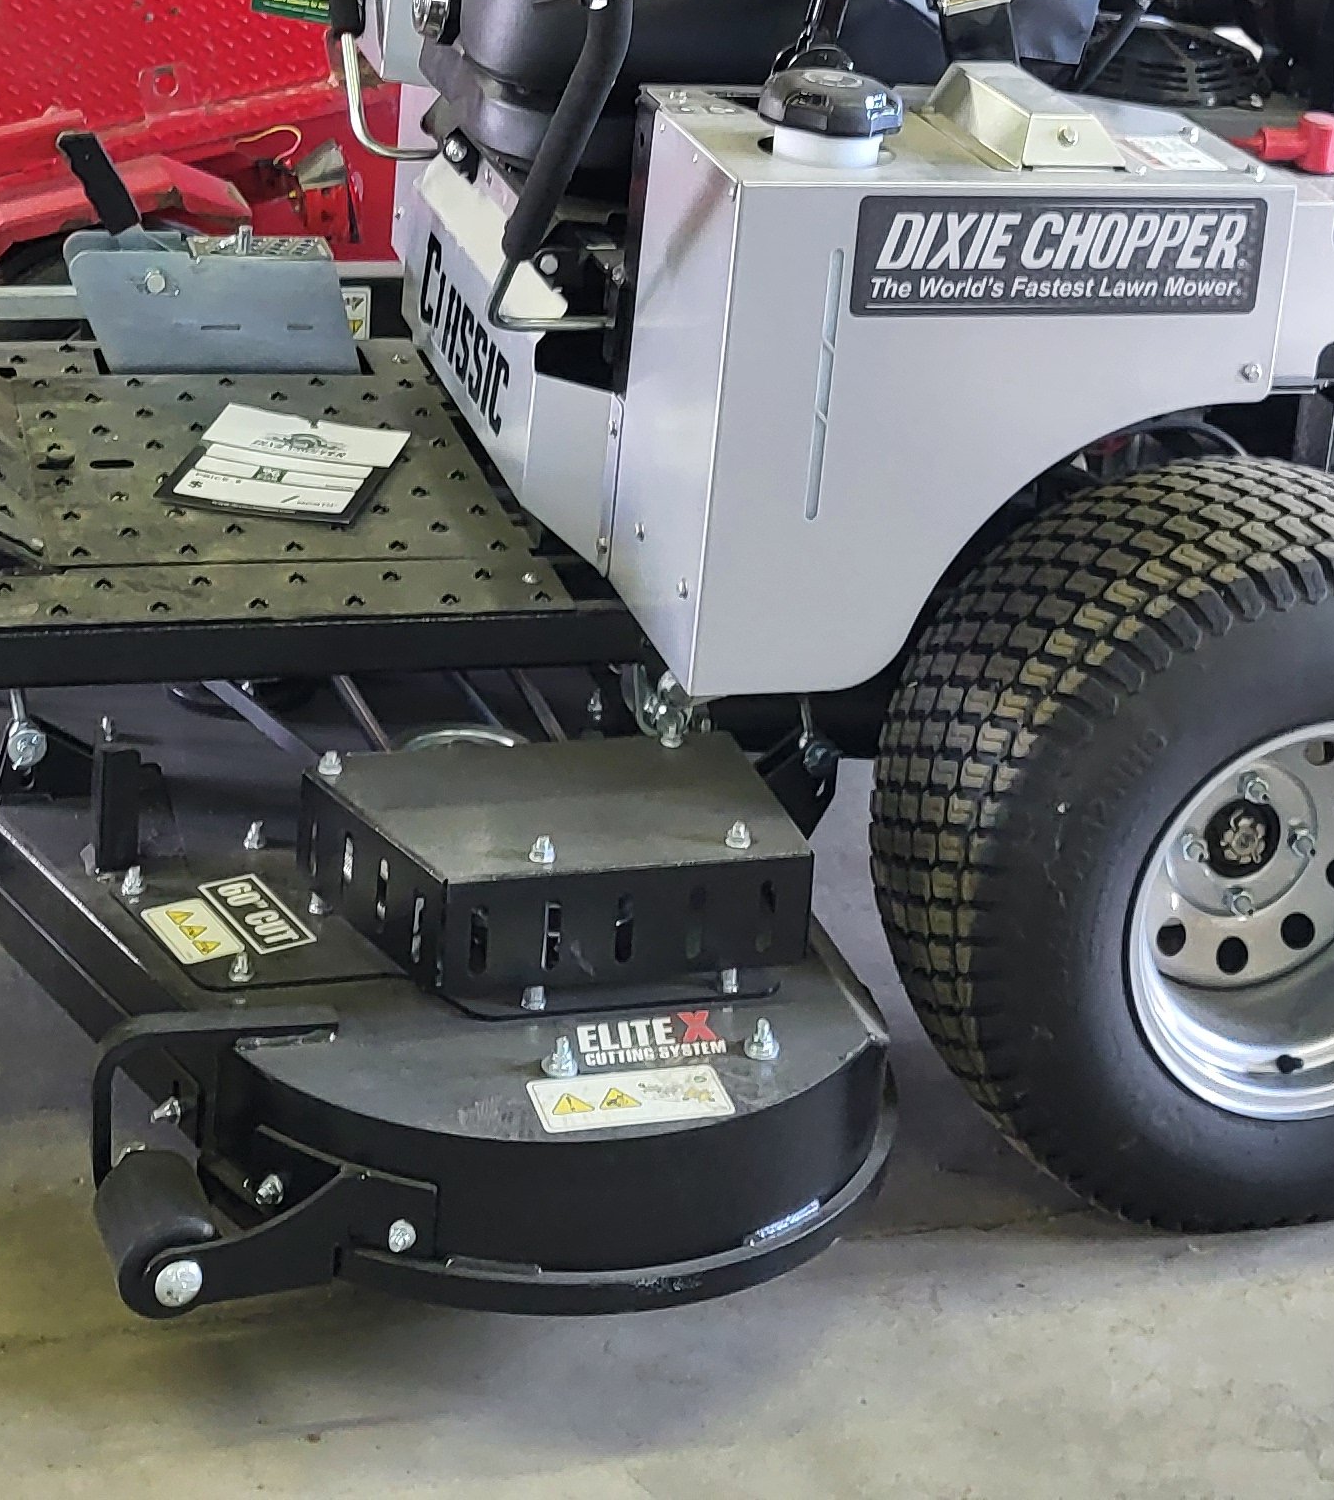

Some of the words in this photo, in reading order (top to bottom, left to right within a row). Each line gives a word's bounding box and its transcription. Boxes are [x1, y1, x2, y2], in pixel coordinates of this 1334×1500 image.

[874, 210, 1023, 271] DIXIE
[1020, 210, 1247, 271] CHOPPER
[869, 276, 911, 300] The
[919, 276, 1005, 300] World's
[1010, 275, 1095, 299] Fastest
[1098, 276, 1158, 299] Lawn
[1163, 276, 1238, 298] Mower
[420, 231, 510, 438] CLASSIC
[244, 909, 301, 944] CUT
[576, 1015, 676, 1054] ELITE
[676, 1009, 718, 1044] X
[584, 1045, 656, 1067] CUTTING
[658, 1038, 727, 1060] SYSTEM
